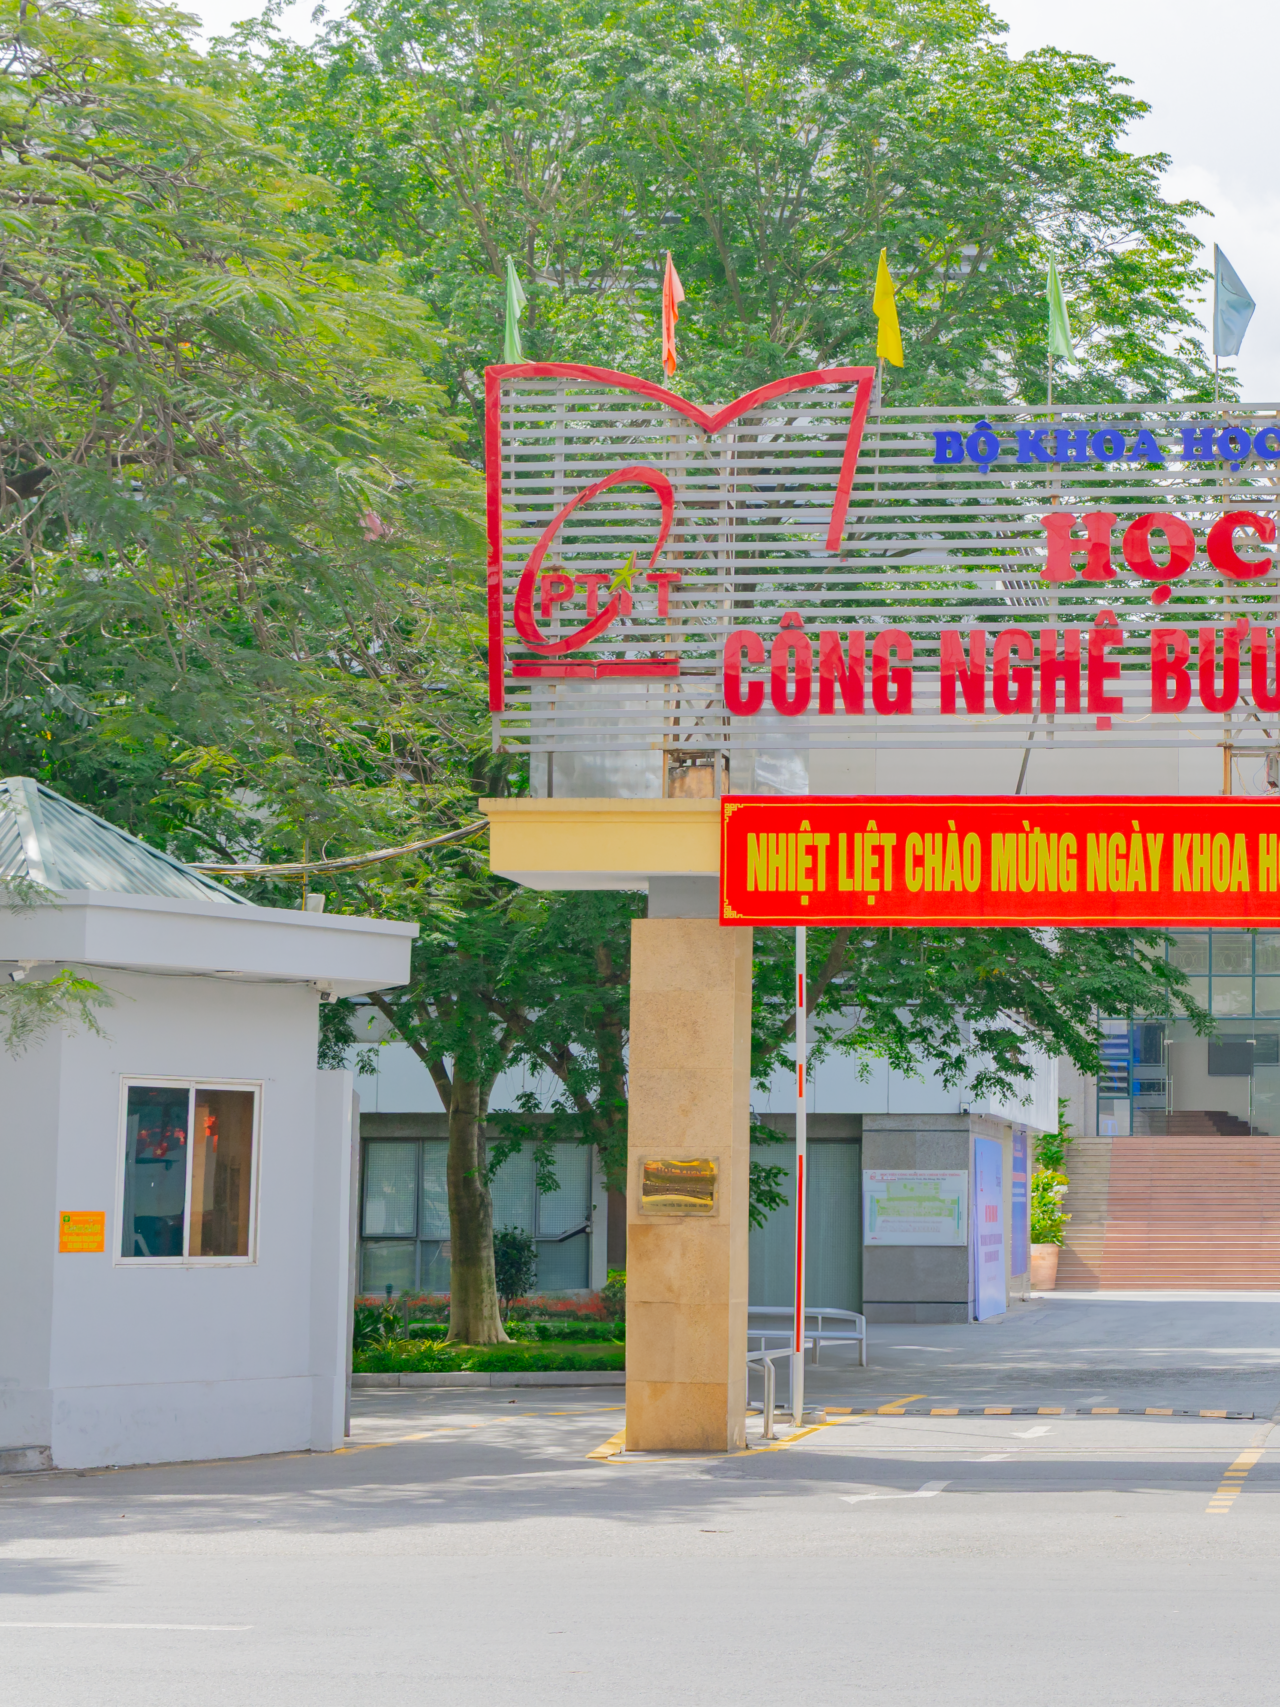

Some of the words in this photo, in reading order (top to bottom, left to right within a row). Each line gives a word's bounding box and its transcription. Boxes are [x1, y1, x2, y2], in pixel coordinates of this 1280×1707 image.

[933, 421, 999, 473] BỘ
[1016, 428, 1165, 464] KHOA
[1040, 511, 1276, 606] HỌC
[723, 611, 913, 716] CÔNG
[939, 610, 1123, 730] NGHỆ
[746, 819, 830, 906] NHIỆT
[838, 819, 897, 906] LIỆT
[904, 819, 982, 893] CHÀO
[991, 820, 1078, 893] MỪNG
[1086, 820, 1164, 893] NGÀY
[1173, 832, 1250, 893] KHOA
